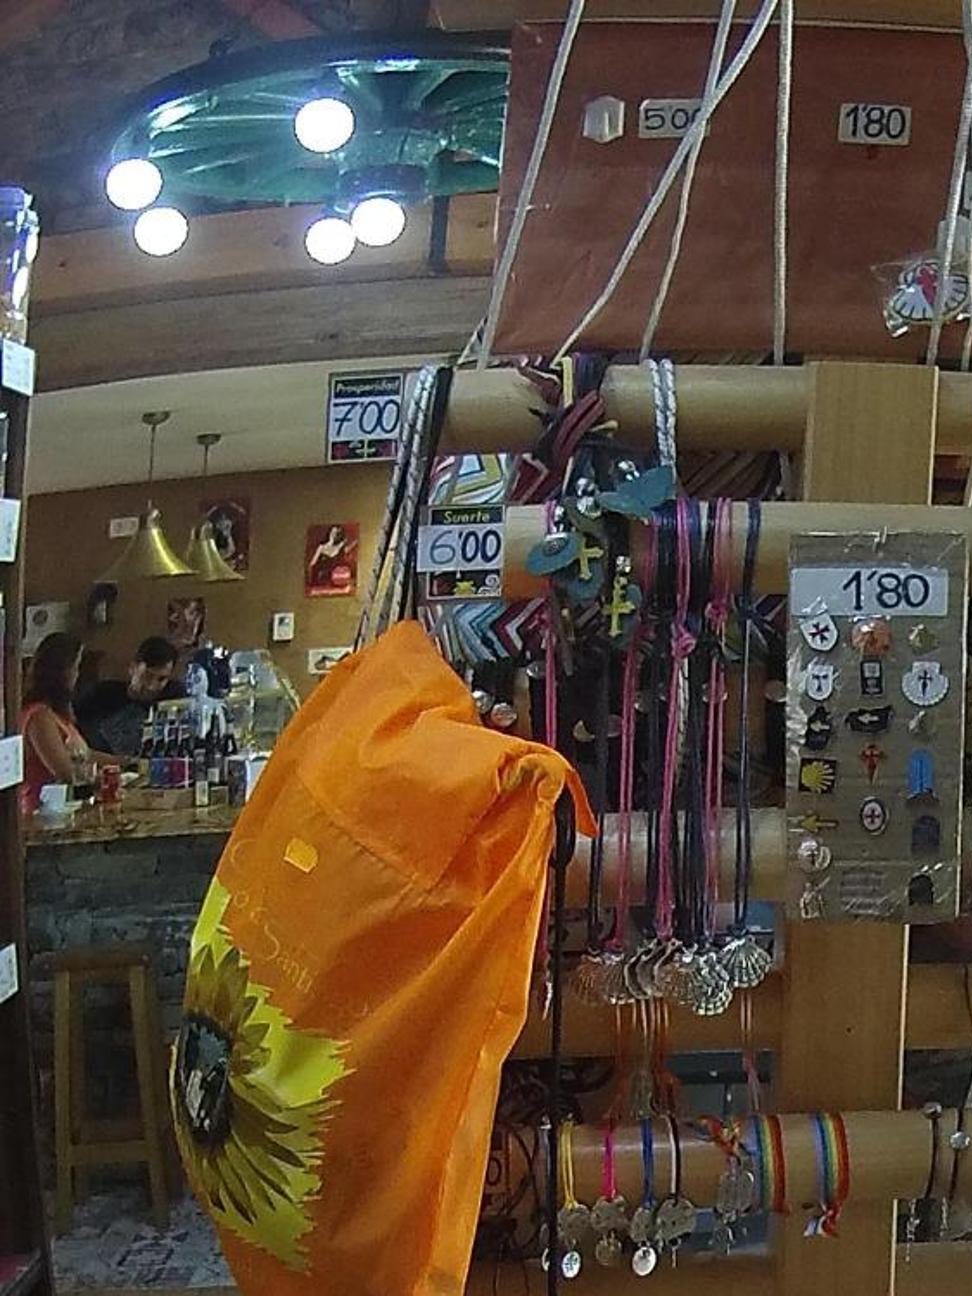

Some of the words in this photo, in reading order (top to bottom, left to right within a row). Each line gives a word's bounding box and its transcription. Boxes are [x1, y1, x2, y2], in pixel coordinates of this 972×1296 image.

[845, 103, 906, 139] 1'80
[332, 398, 401, 437] 7'00
[443, 510, 491, 524] Suerte
[429, 529, 502, 565] 6'00
[842, 568, 930, 612] 1'80
